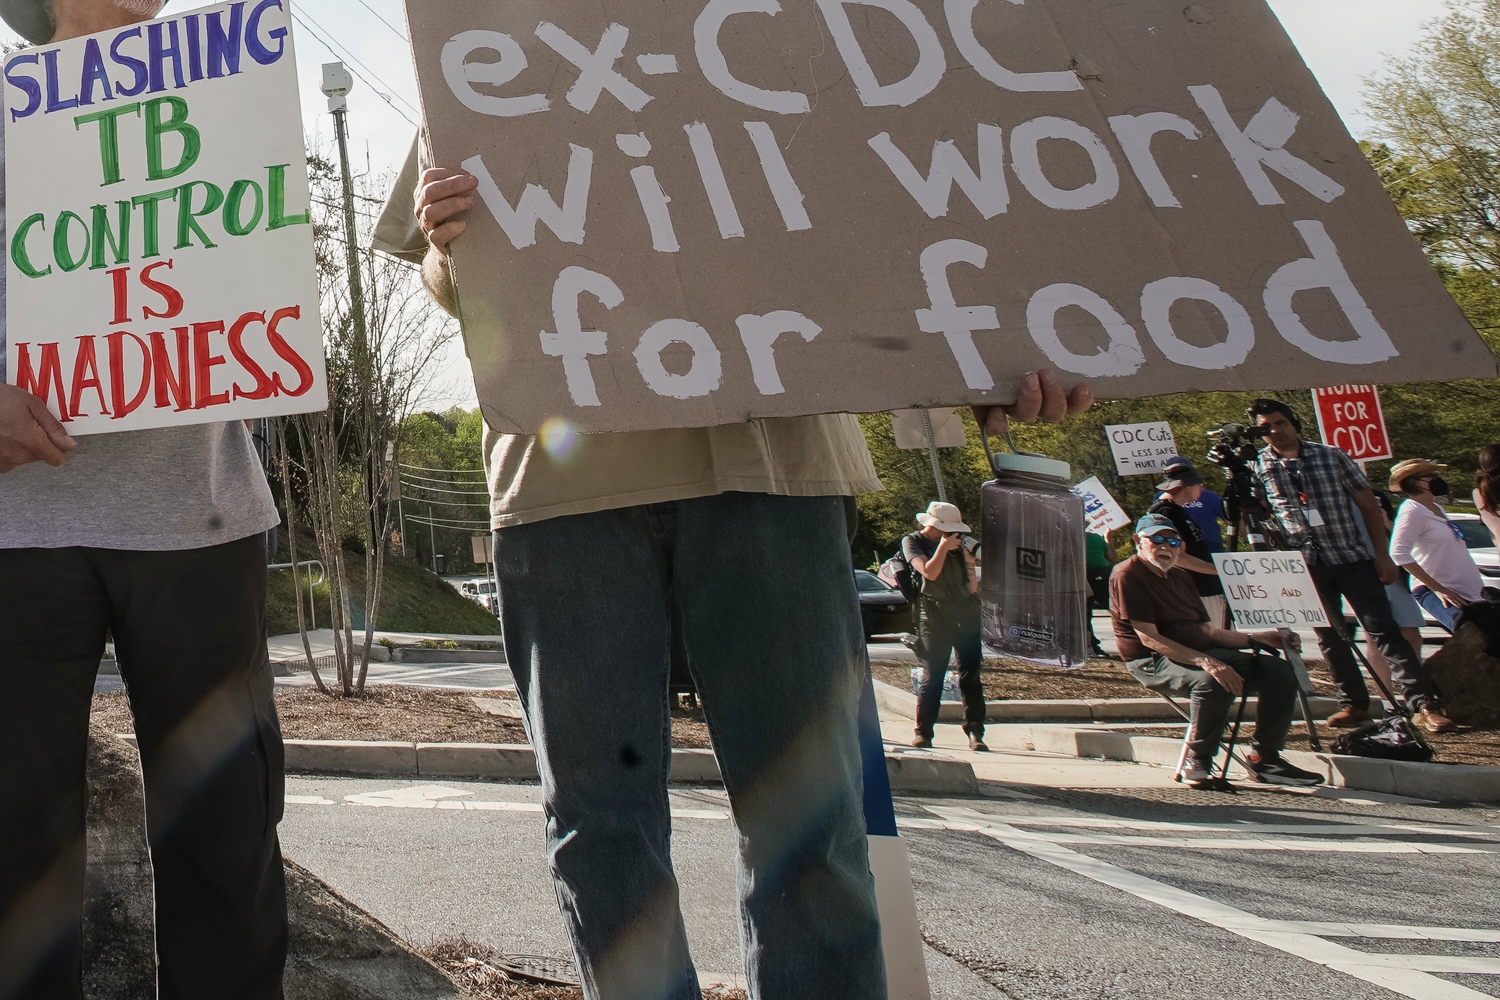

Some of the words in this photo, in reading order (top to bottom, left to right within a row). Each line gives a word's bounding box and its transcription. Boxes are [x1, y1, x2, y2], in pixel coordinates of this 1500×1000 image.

[74, 95, 201, 187] TB
[460, 121, 812, 252] will
[867, 83, 1346, 220] work
[10, 163, 310, 279] CONTROL
[105, 258, 185, 326] IS
[539, 265, 824, 407] for
[914, 219, 1400, 391] food
[14, 305, 314, 422] MADNESS
[1333, 401, 1369, 422] FOR
[1112, 429, 1145, 444] CDC
[1147, 427, 1172, 442] Cuts
[1333, 423, 1382, 456] CDC
[1131, 448, 1152, 458] LESS
[1155, 446, 1176, 456] SAFE
[1134, 460, 1157, 468] HURT
[1222, 559, 1256, 576] CDC
[1261, 557, 1306, 574] SAVES
[1228, 584, 1268, 600] LIVES
[1281, 587, 1302, 598] AND
[1234, 608, 1297, 625] PROTECTS
[1299, 607, 1327, 623] YOU!
